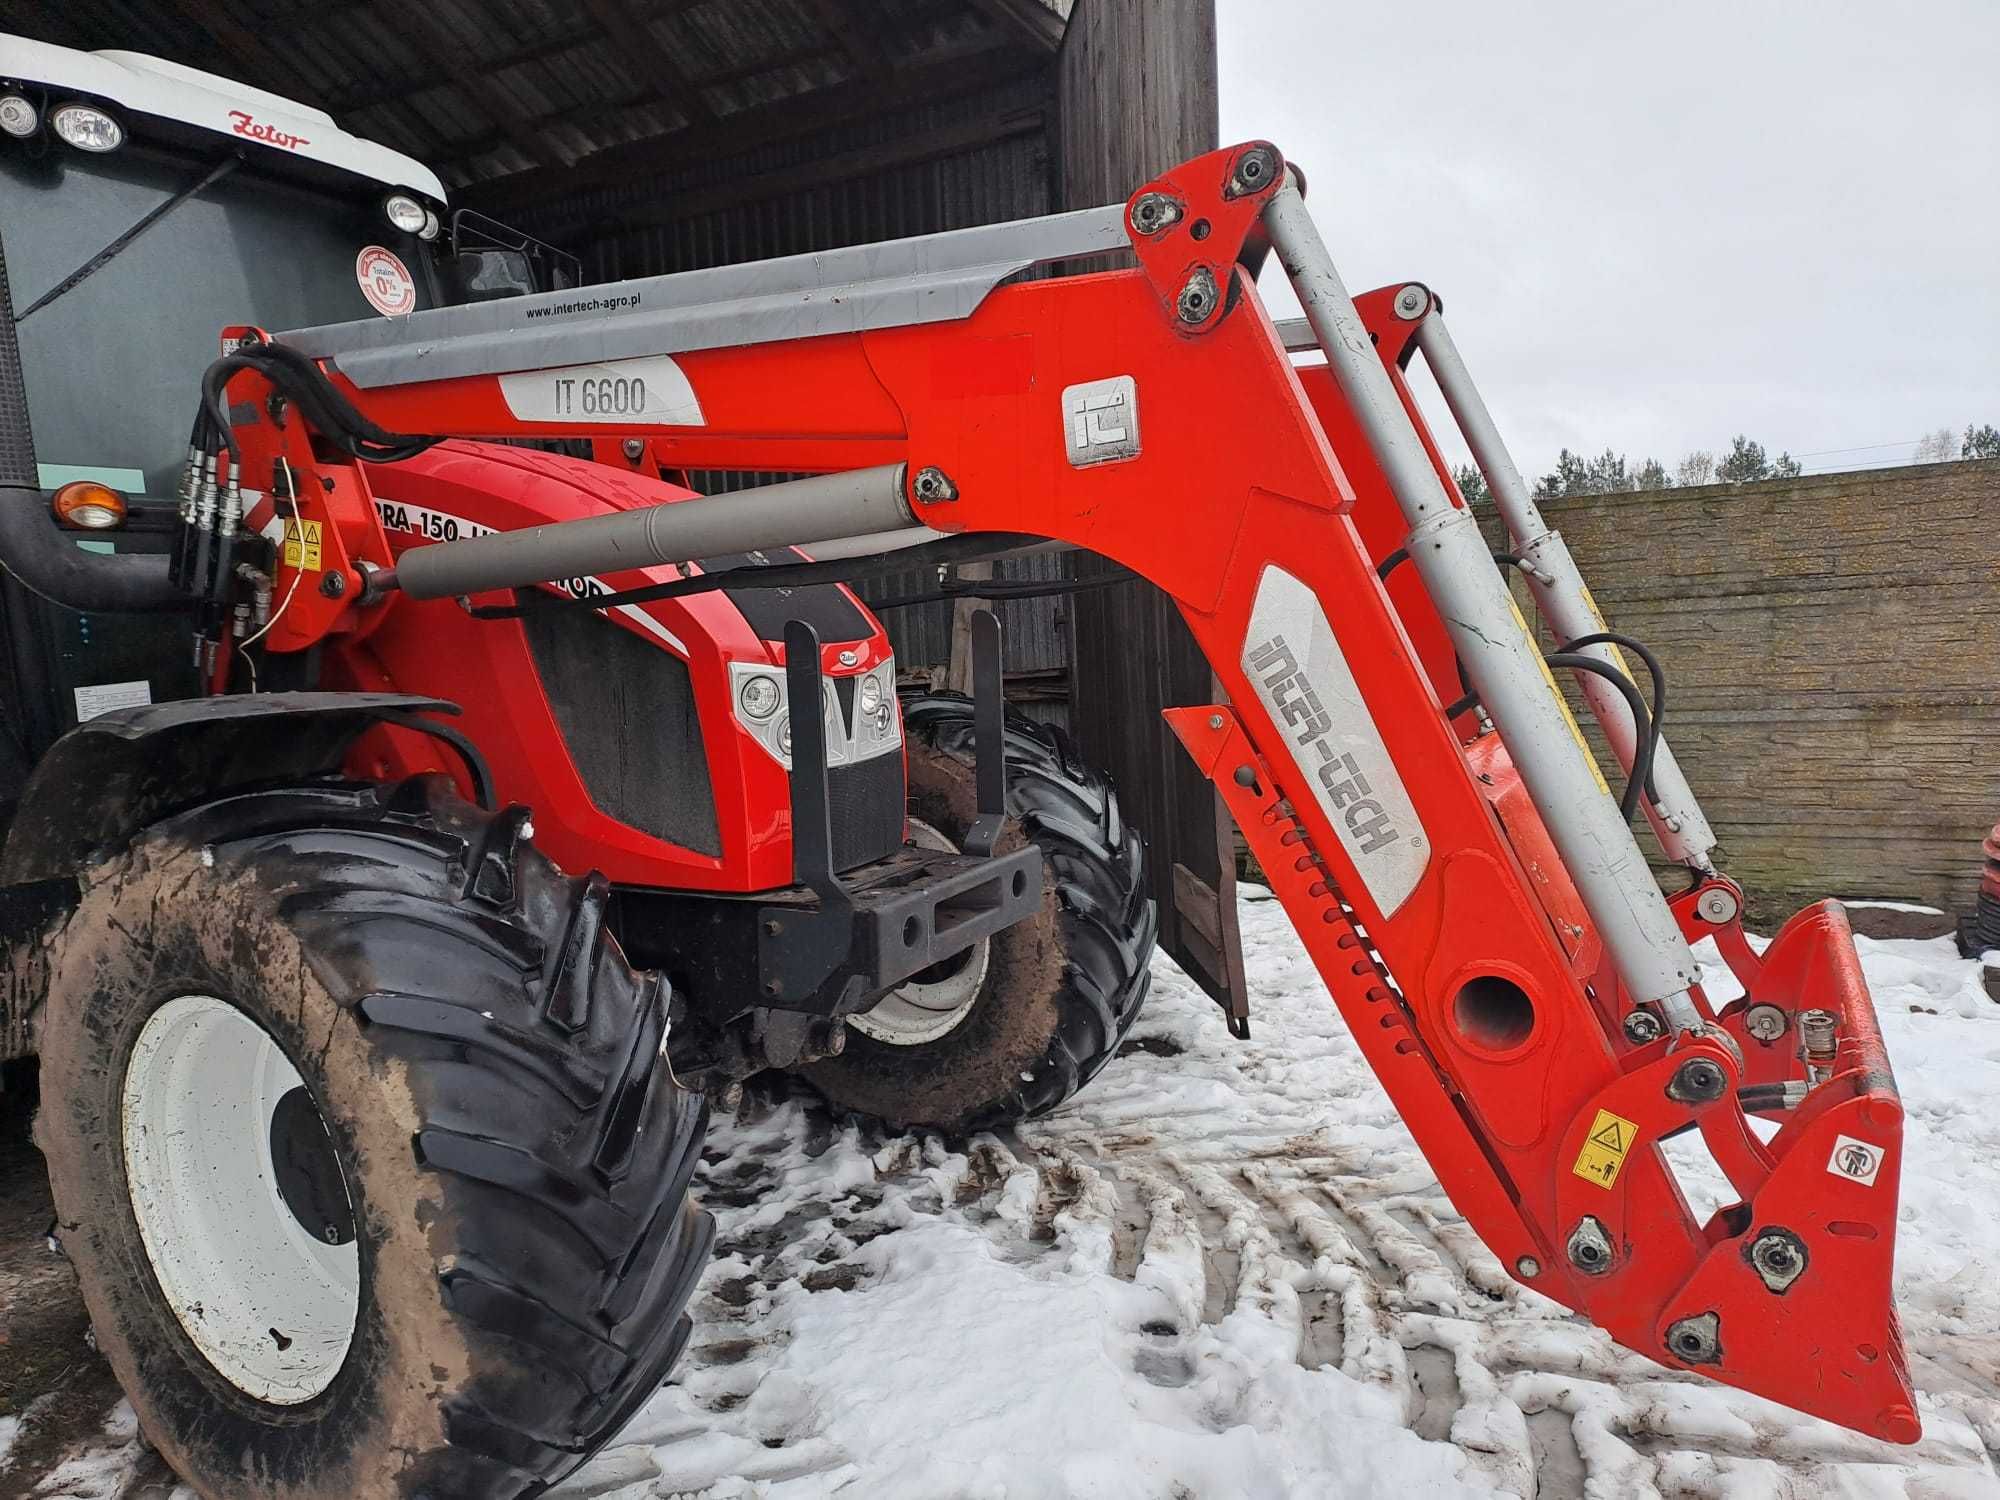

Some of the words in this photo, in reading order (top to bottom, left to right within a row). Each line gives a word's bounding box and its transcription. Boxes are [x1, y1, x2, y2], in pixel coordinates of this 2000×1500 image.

[228, 109, 311, 149] Zetor
[526, 292, 641, 318] www.intertech-agro.pl
[555, 379, 576, 414] IT
[582, 378, 646, 415] 6600
[420, 511, 459, 542] 150
